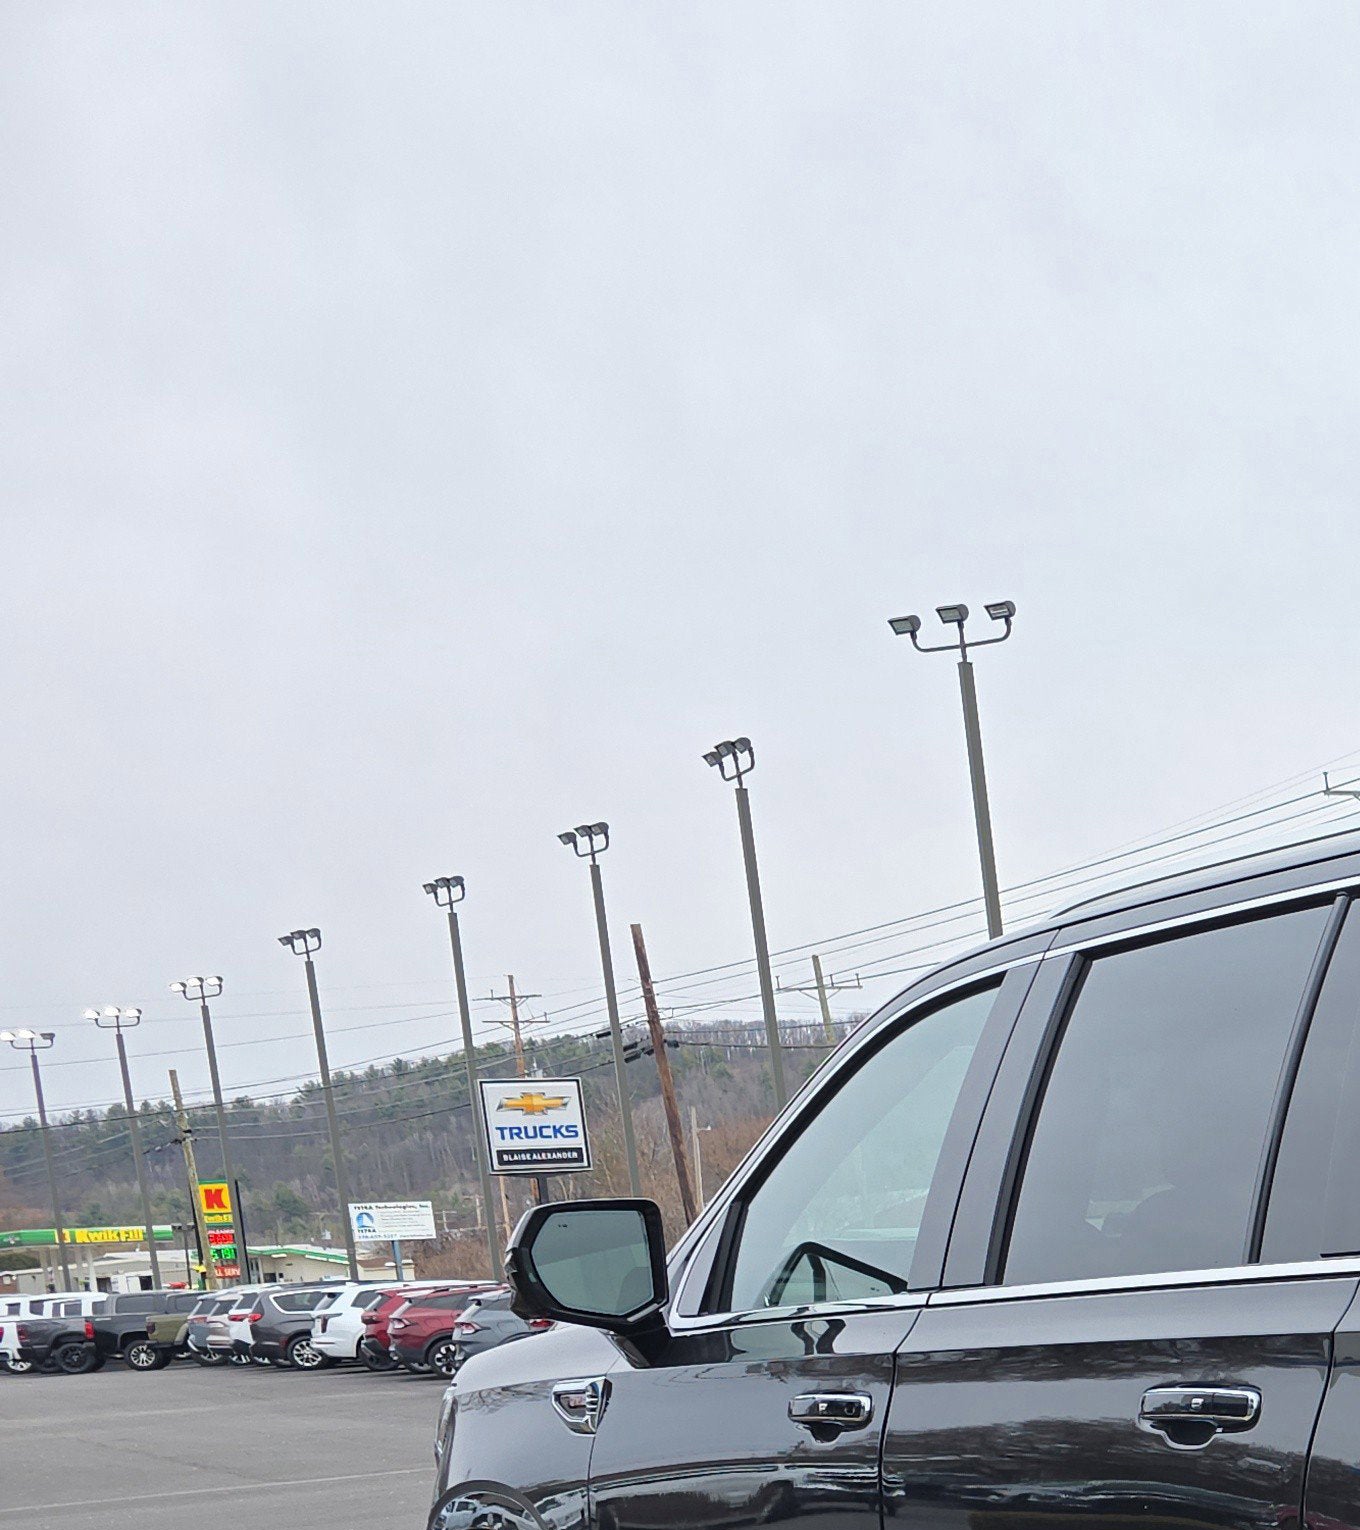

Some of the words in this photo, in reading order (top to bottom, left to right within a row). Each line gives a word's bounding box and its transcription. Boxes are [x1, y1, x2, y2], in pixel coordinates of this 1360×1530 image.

[495, 1124, 579, 1141] TRUCKS
[502, 1153, 532, 1162] BLAISE
[532, 1151, 579, 1161] ALEXANDER
[204, 1189, 227, 1209] K
[75, 1229, 119, 1244] Kwik
